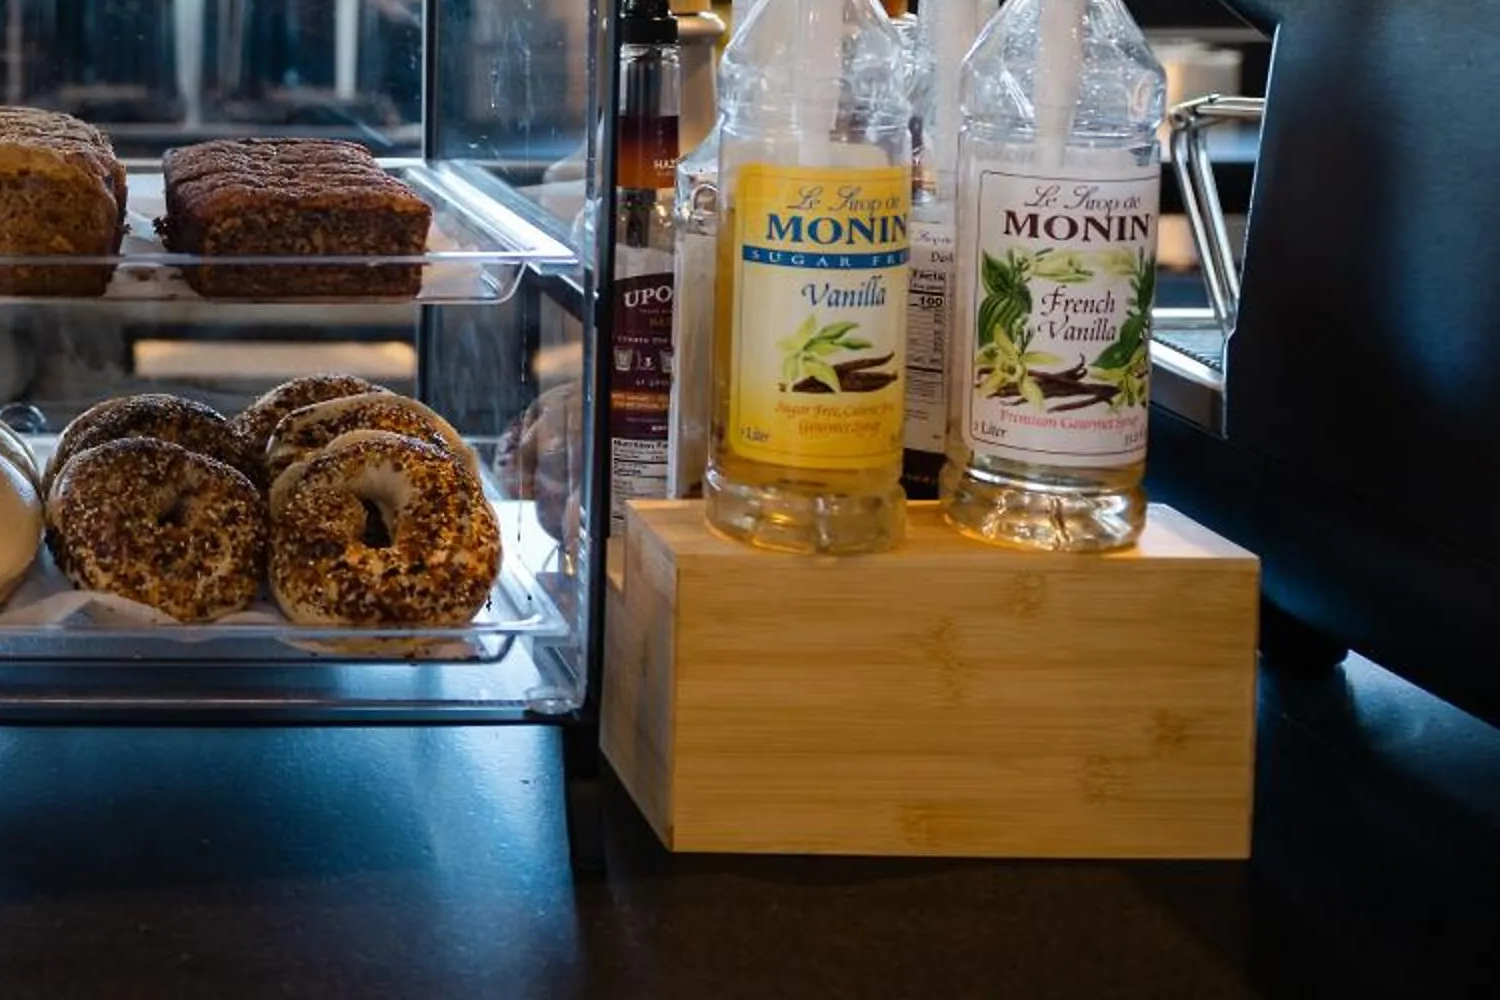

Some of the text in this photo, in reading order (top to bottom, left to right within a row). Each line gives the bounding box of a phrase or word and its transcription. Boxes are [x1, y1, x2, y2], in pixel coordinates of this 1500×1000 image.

[787, 184, 823, 211] Le
[1024, 184, 1061, 208] Le
[766, 212, 908, 245] MONIN
[1003, 209, 1151, 242] MONIN
[751, 250, 851, 267] SUGAR
[624, 285, 673, 308] UPO
[801, 275, 888, 309] Vanilla
[1040, 284, 1116, 317] French
[1037, 315, 1118, 342] Vanilla
